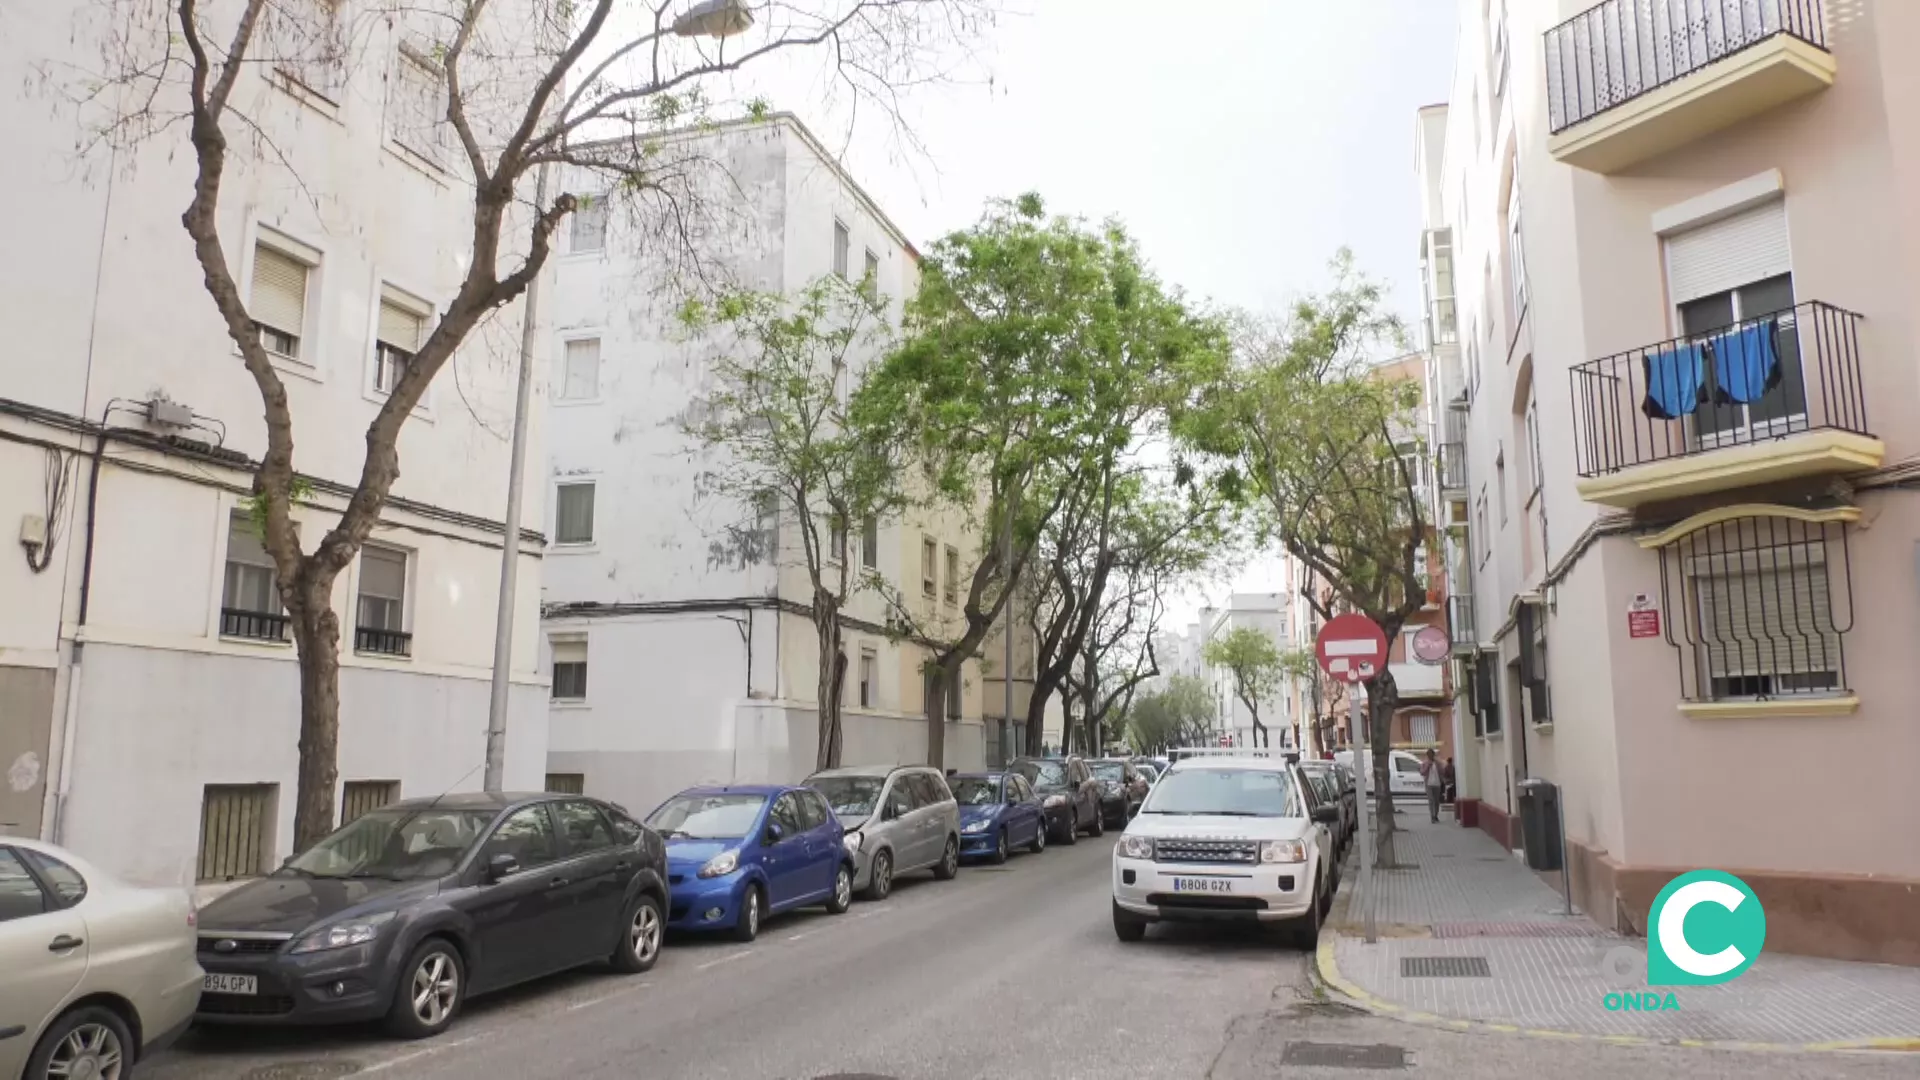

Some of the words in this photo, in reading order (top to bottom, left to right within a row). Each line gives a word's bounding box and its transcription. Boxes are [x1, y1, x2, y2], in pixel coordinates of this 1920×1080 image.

[1181, 879, 1207, 890] 6806
[1211, 880, 1231, 892] GZX
[204, 975, 227, 990] 894
[230, 976, 253, 992] GPV
